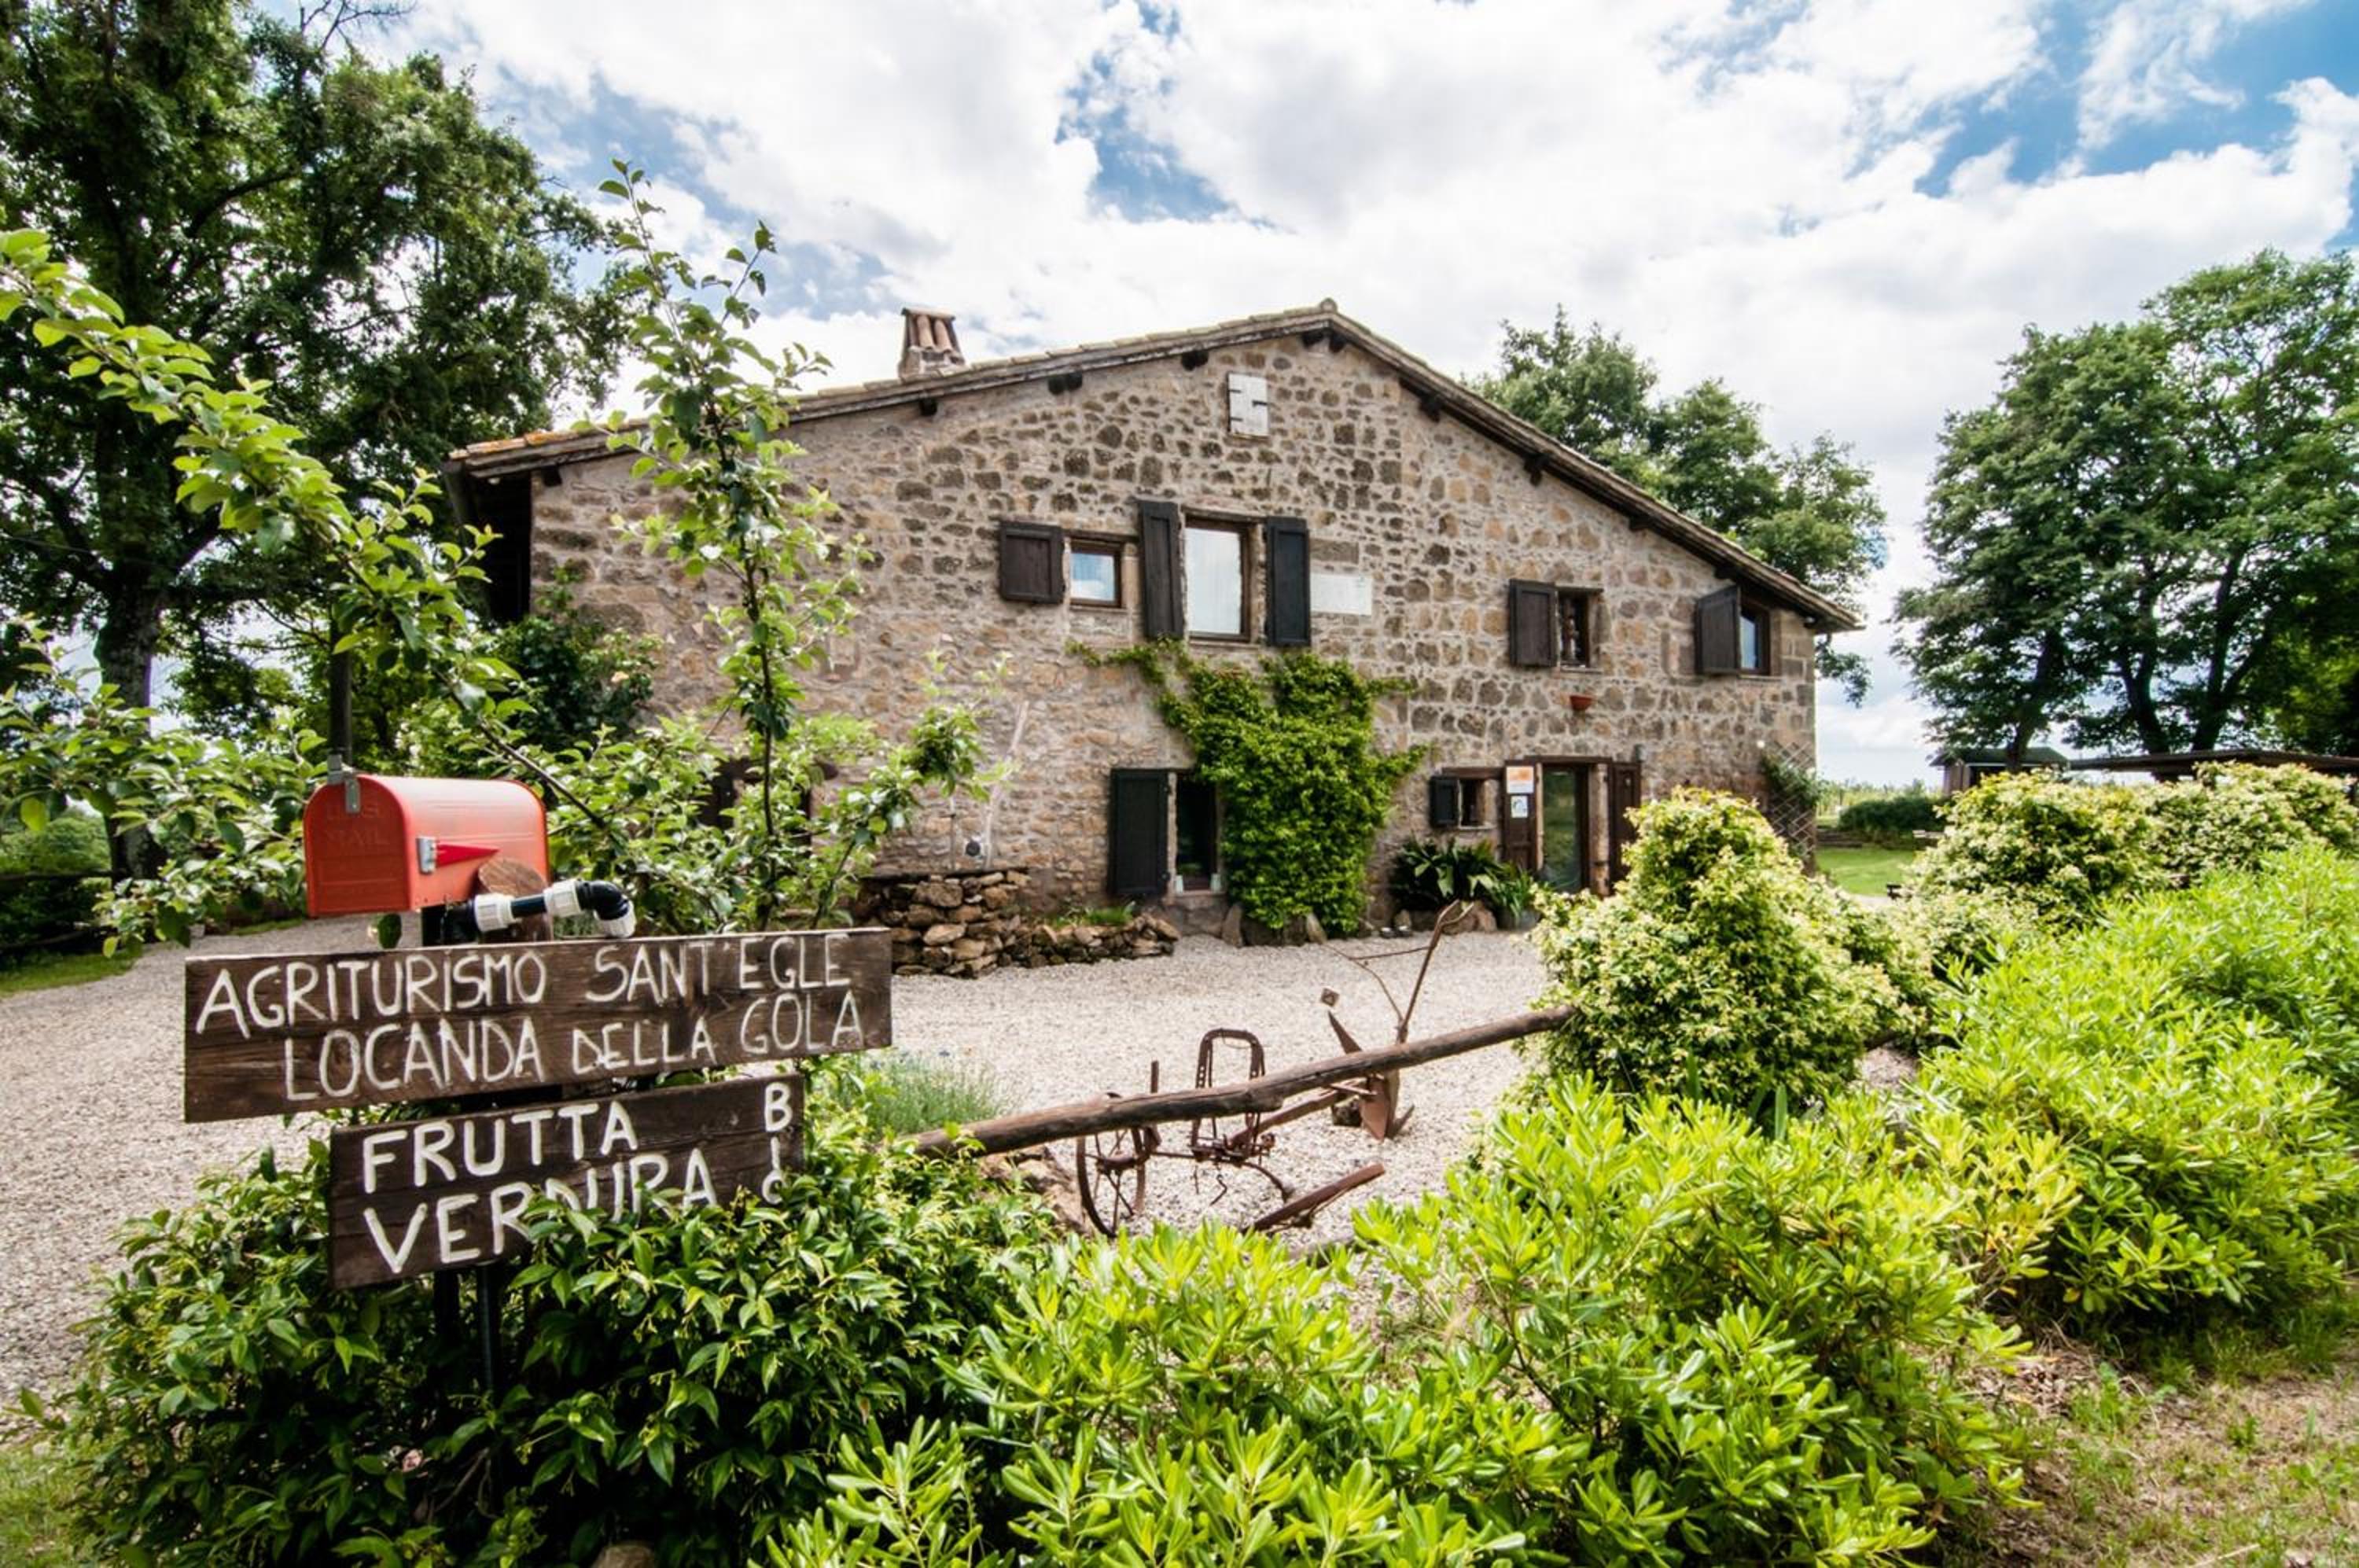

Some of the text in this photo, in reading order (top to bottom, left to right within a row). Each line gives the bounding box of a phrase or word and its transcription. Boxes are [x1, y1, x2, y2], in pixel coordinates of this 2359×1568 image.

[196, 933, 851, 1038] AGRITURISMO SANT'EGLE
[285, 989, 864, 1100] LOCANDA DELLA GOLA
[362, 1101, 638, 1194] FRUTTA
